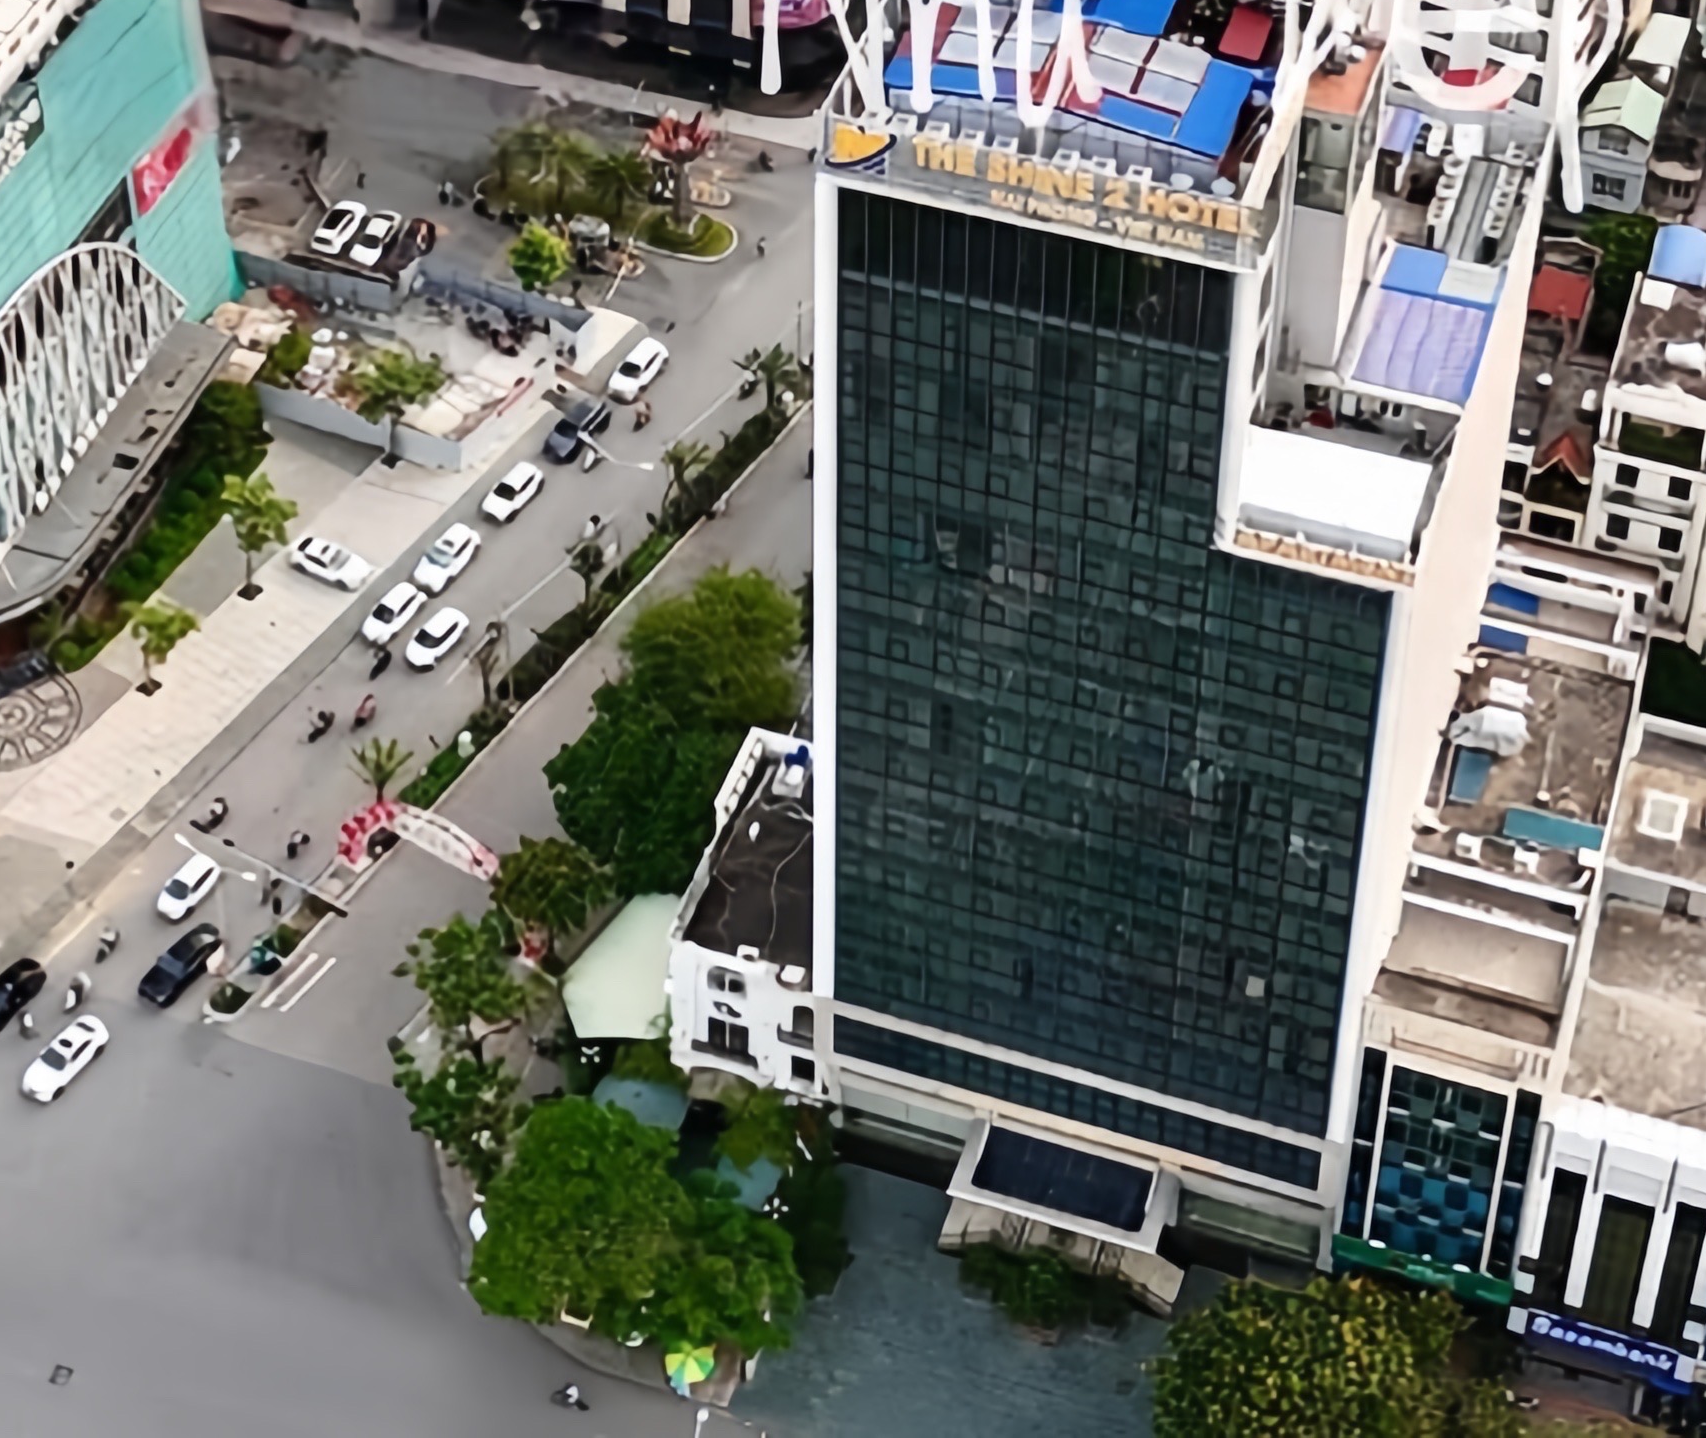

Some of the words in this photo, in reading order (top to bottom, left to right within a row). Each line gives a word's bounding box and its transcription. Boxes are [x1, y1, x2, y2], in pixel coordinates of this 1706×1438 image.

[912, 135, 977, 177] THE
[986, 150, 1095, 202] SHINE
[1102, 176, 1131, 210] 2
